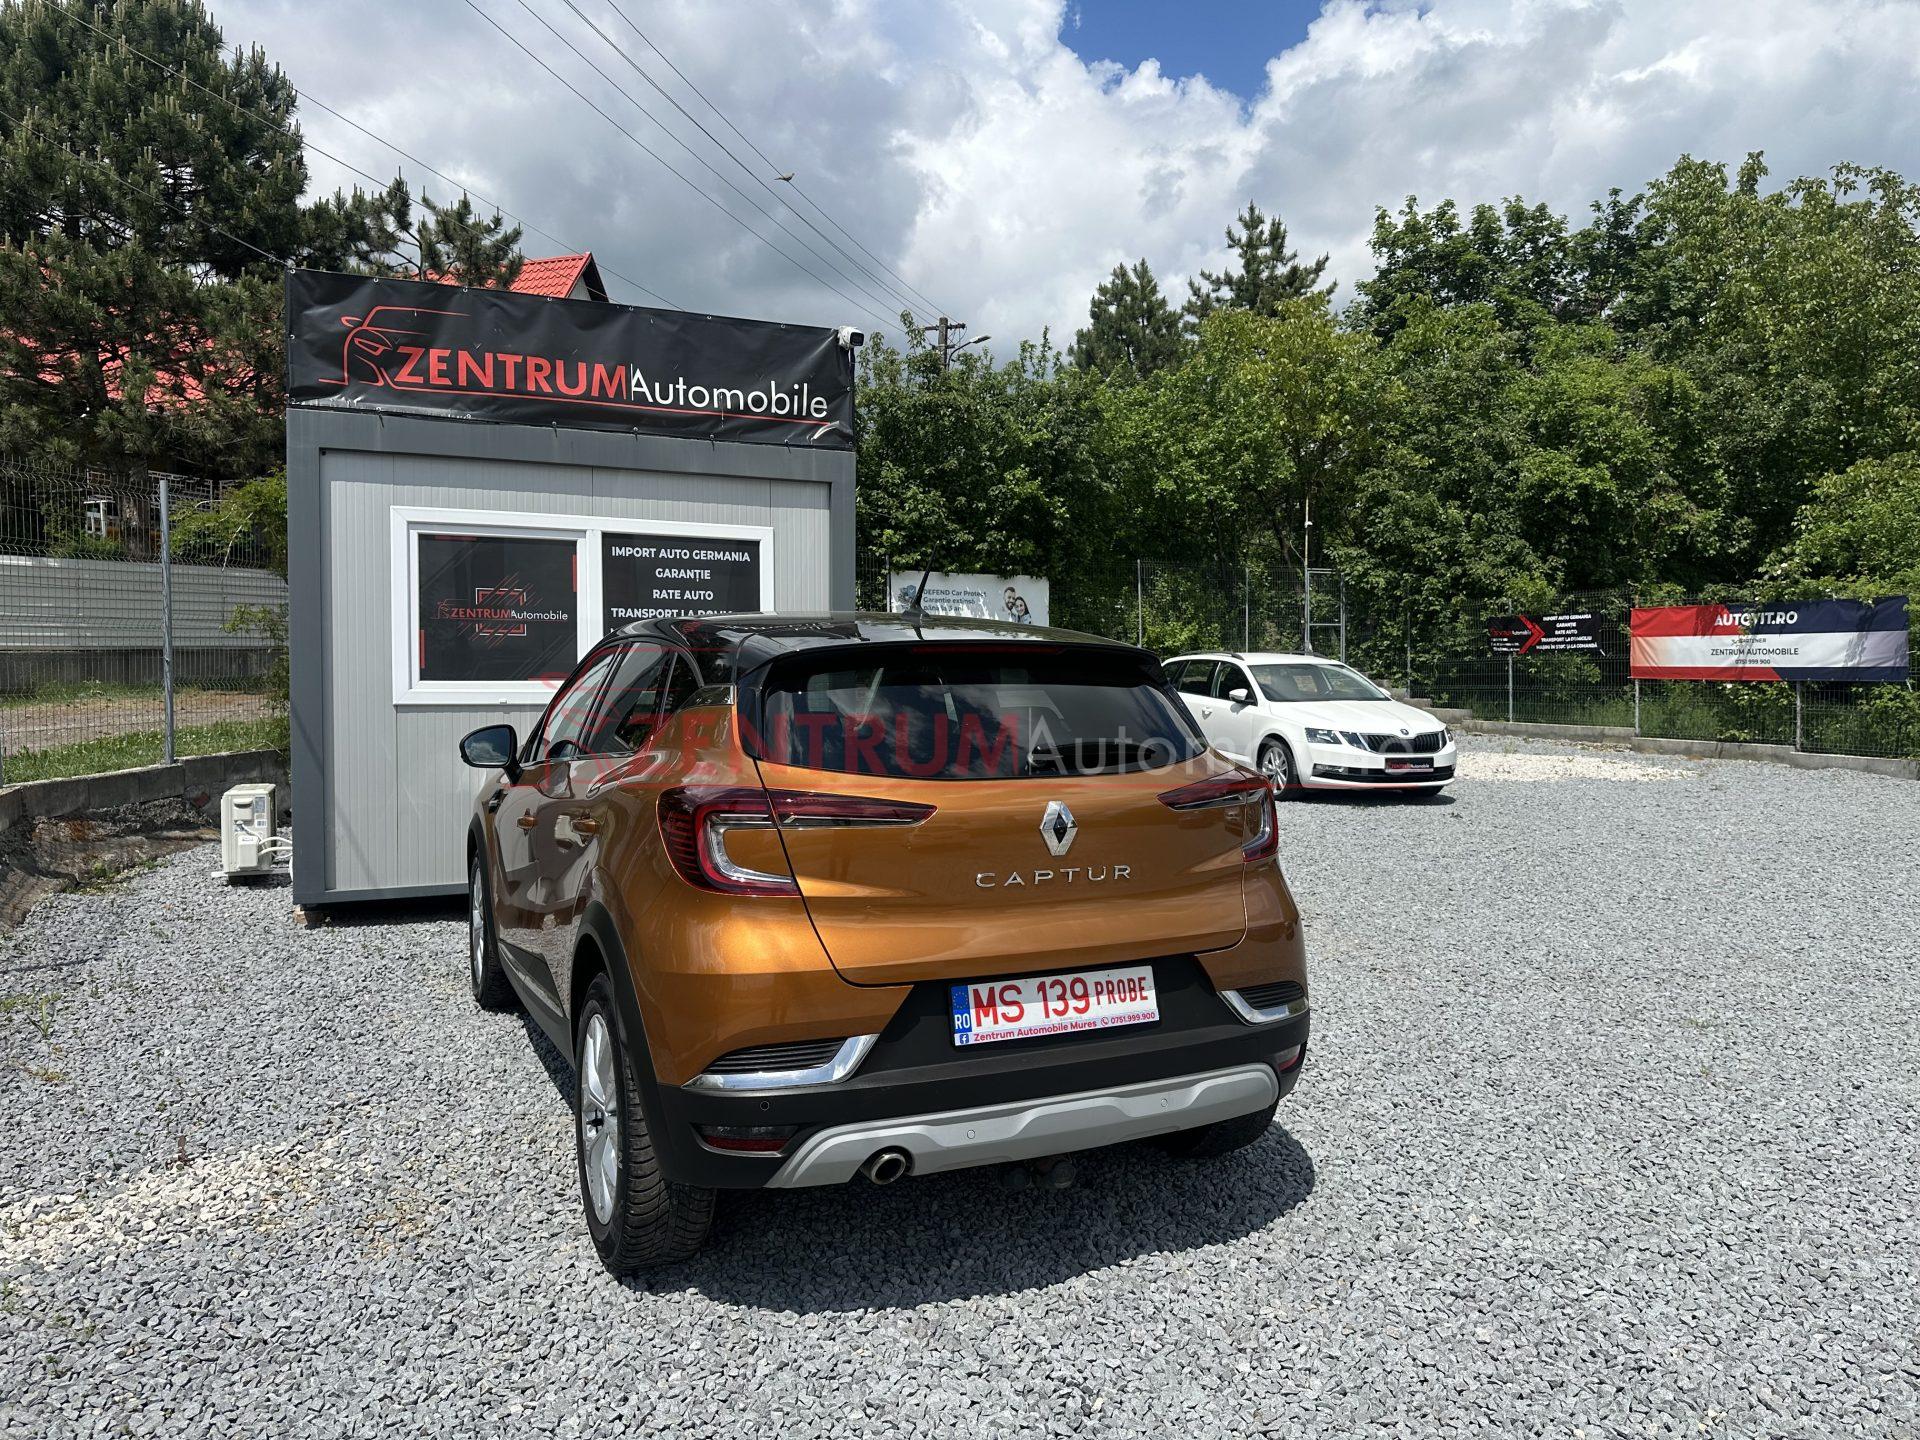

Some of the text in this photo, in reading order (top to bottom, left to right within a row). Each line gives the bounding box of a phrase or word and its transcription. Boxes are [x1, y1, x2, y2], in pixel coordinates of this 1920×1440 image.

[395, 345, 829, 419] ZENTRUM Automobile
[611, 546, 751, 562] IMPORT AUTO GERMANIA
[655, 568, 711, 582] GARANȚIE
[653, 589, 714, 601] RATE AUTO
[451, 607, 568, 620] ZENTRUM Automobile
[611, 607, 678, 619] TRANSPORT
[1710, 647, 1799, 656] ZENTRUM AUTOMOBILE
[975, 864, 1131, 888] CAPTUR
[972, 976, 1149, 1028] MS 139 PROBE
[955, 1013, 971, 1029] RO
[974, 1012, 1156, 1042] Zentrum Automobile Mures 0751.999.900
